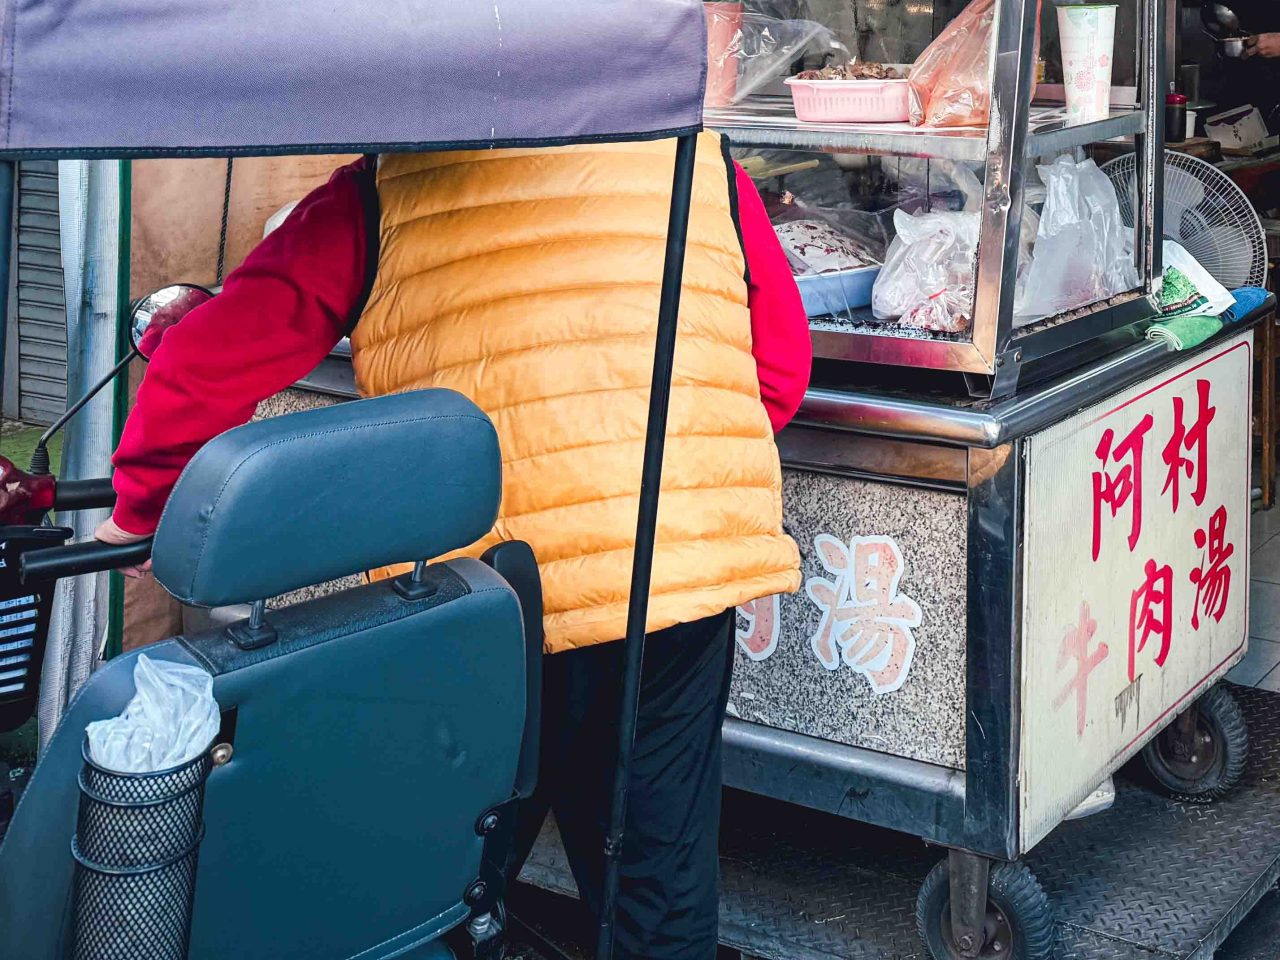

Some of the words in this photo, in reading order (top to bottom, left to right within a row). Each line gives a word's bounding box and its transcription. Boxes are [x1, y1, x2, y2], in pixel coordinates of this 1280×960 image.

[1092, 379, 1216, 561] 阿村
[1052, 505, 1233, 737] 牛肉湯
